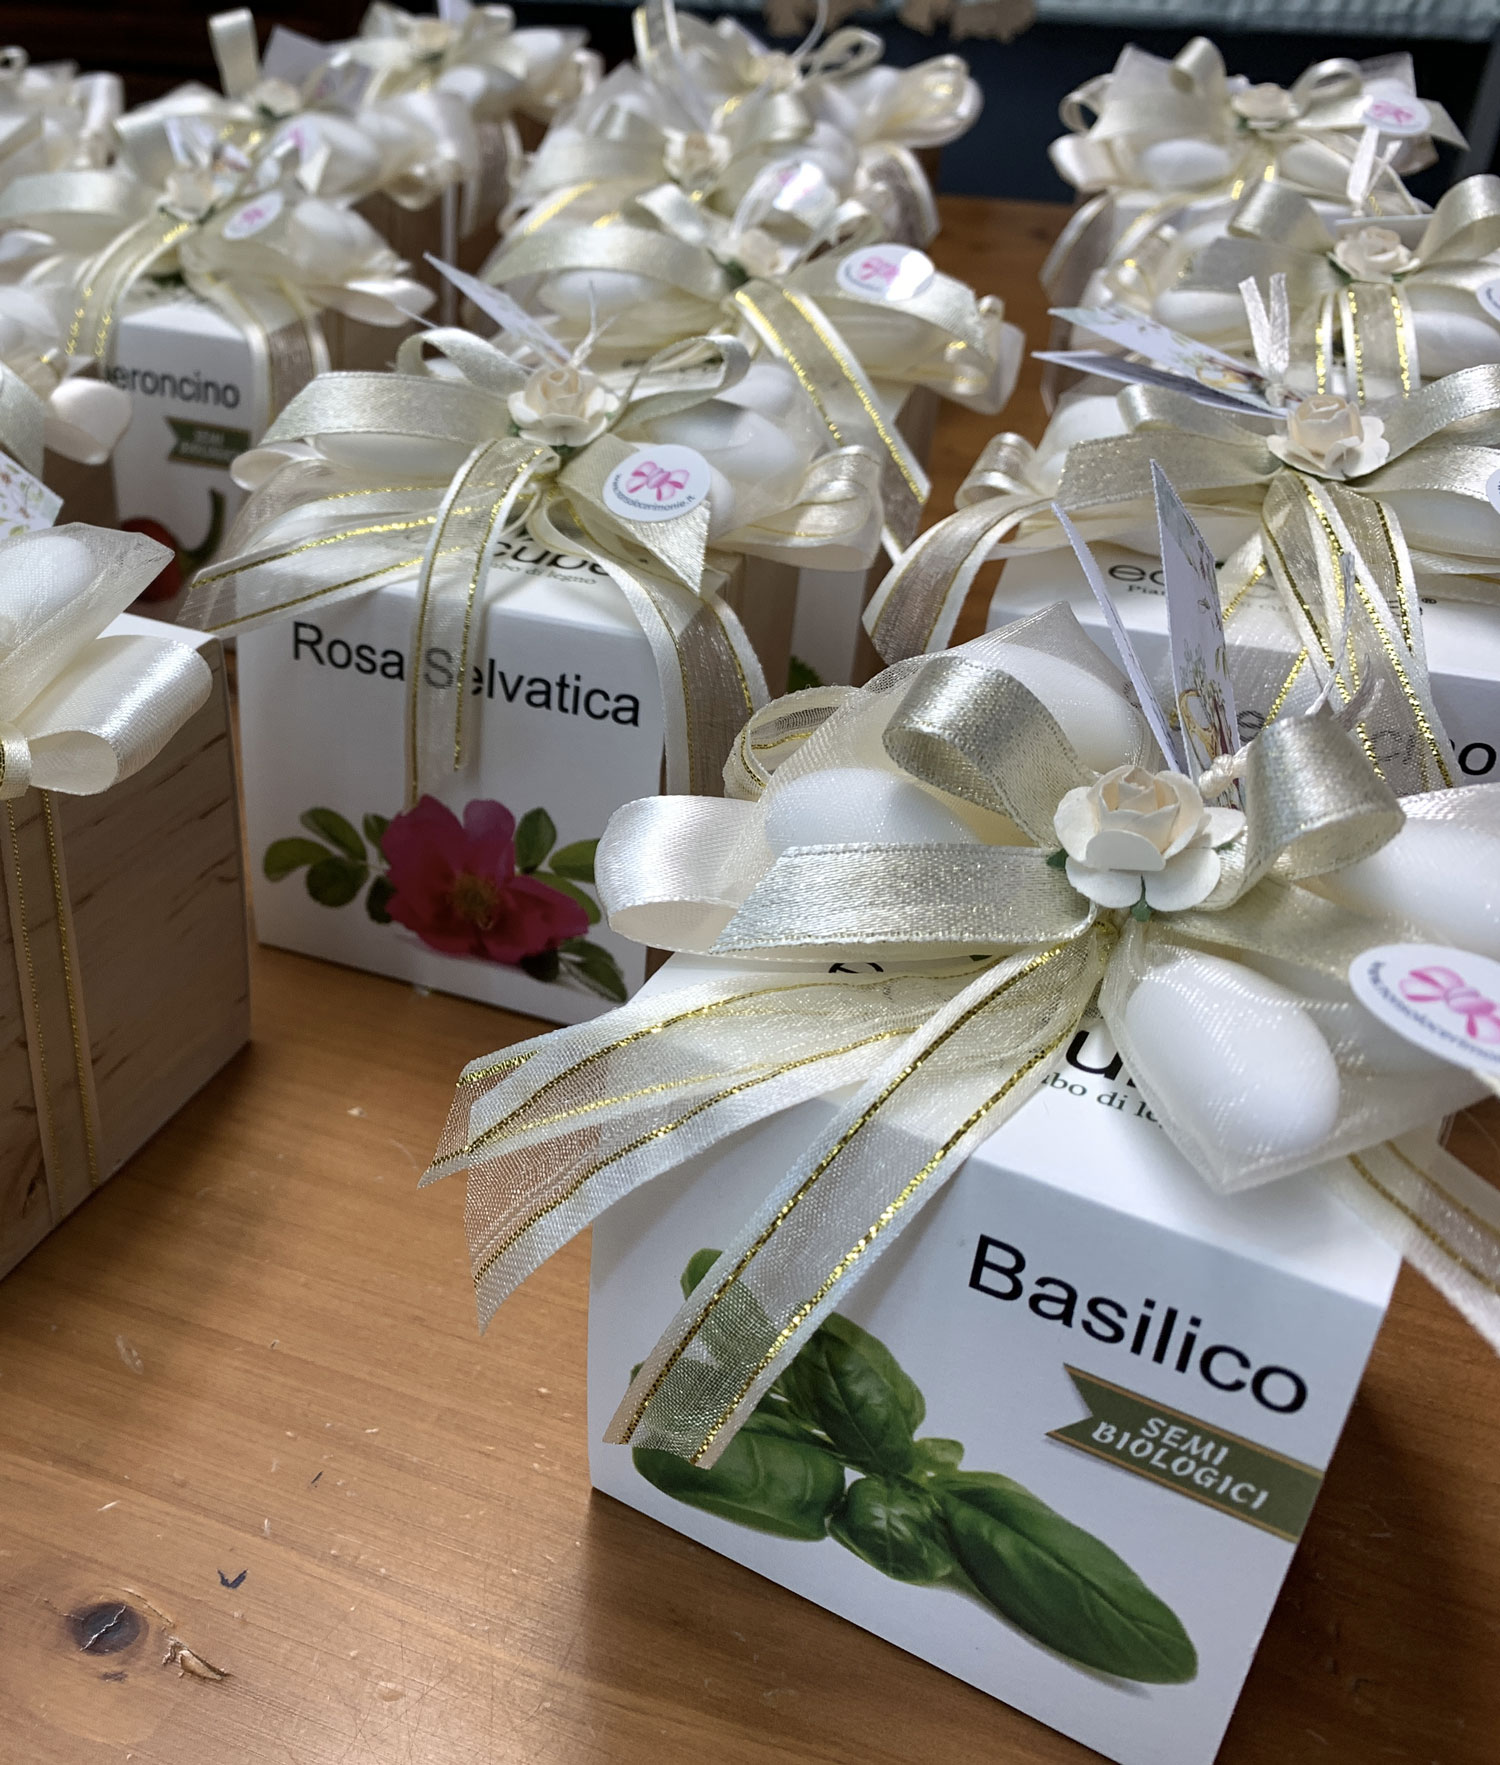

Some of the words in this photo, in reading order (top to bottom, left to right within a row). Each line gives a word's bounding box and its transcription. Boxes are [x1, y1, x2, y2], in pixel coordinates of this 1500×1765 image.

[105, 365, 241, 409] eroncino
[293, 621, 405, 682] Rosa
[423, 647, 640, 727] Selvatica
[1096, 1091, 1128, 1112] di
[968, 1233, 1308, 1415] Basilico
[1091, 1421, 1269, 1510] BIOLOGICI
[1141, 1416, 1229, 1466] SEMI
